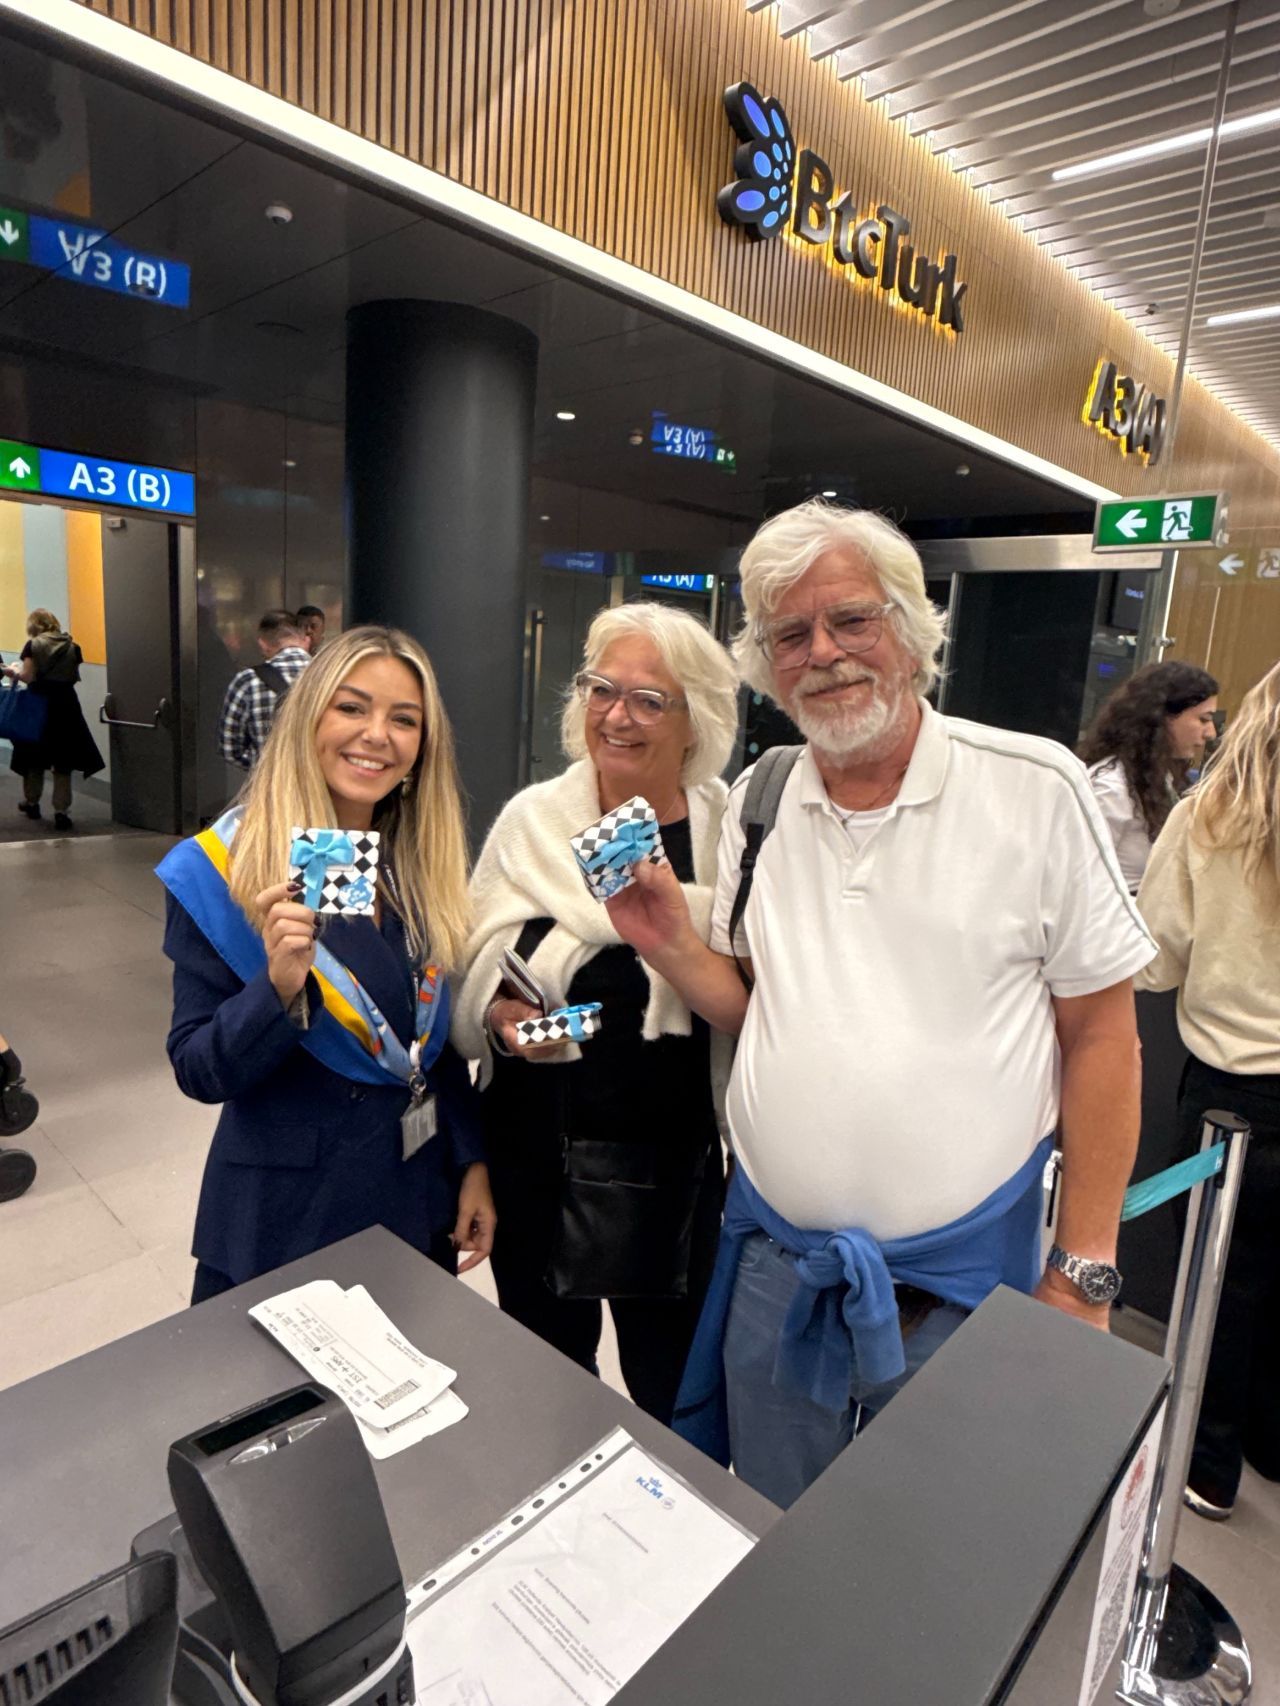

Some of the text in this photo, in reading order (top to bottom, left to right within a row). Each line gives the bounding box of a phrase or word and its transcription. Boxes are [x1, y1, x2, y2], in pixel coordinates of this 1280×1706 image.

[793, 149, 968, 333] BtcTurk
[68, 462, 172, 507] A3 (B)
[635, 1476, 664, 1500] KLM
